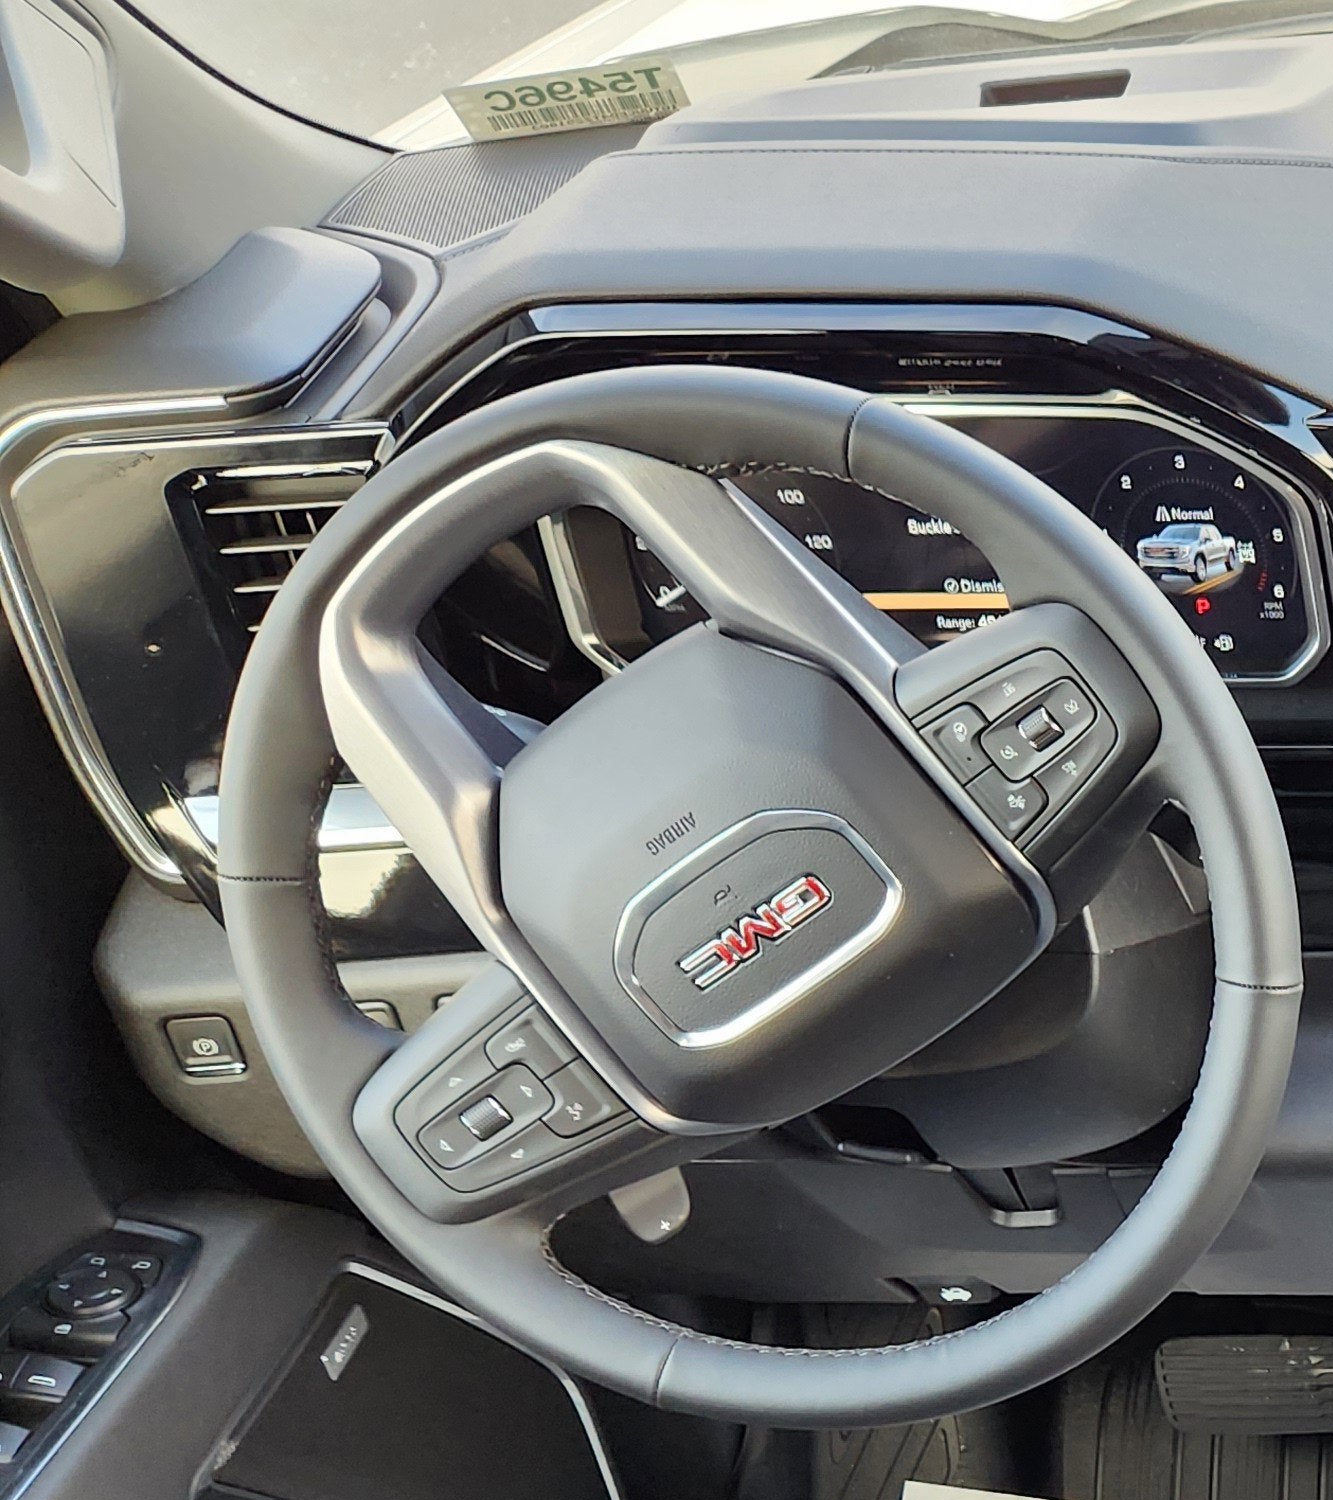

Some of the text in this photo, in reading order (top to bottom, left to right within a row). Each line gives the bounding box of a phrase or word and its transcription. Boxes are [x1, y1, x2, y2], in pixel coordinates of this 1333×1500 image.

[1174, 454, 1185, 469] 3
[1120, 474, 1132, 490] 2
[1234, 474, 1245, 490] 4
[777, 489, 805, 505] 100
[1171, 506, 1214, 521] Normal
[907, 518, 952, 535] Buckle
[805, 534, 833, 549] 120
[1196, 597, 1210, 614] P
[646, 812, 696, 856] AIRBAG
[675, 872, 832, 992] GMC
